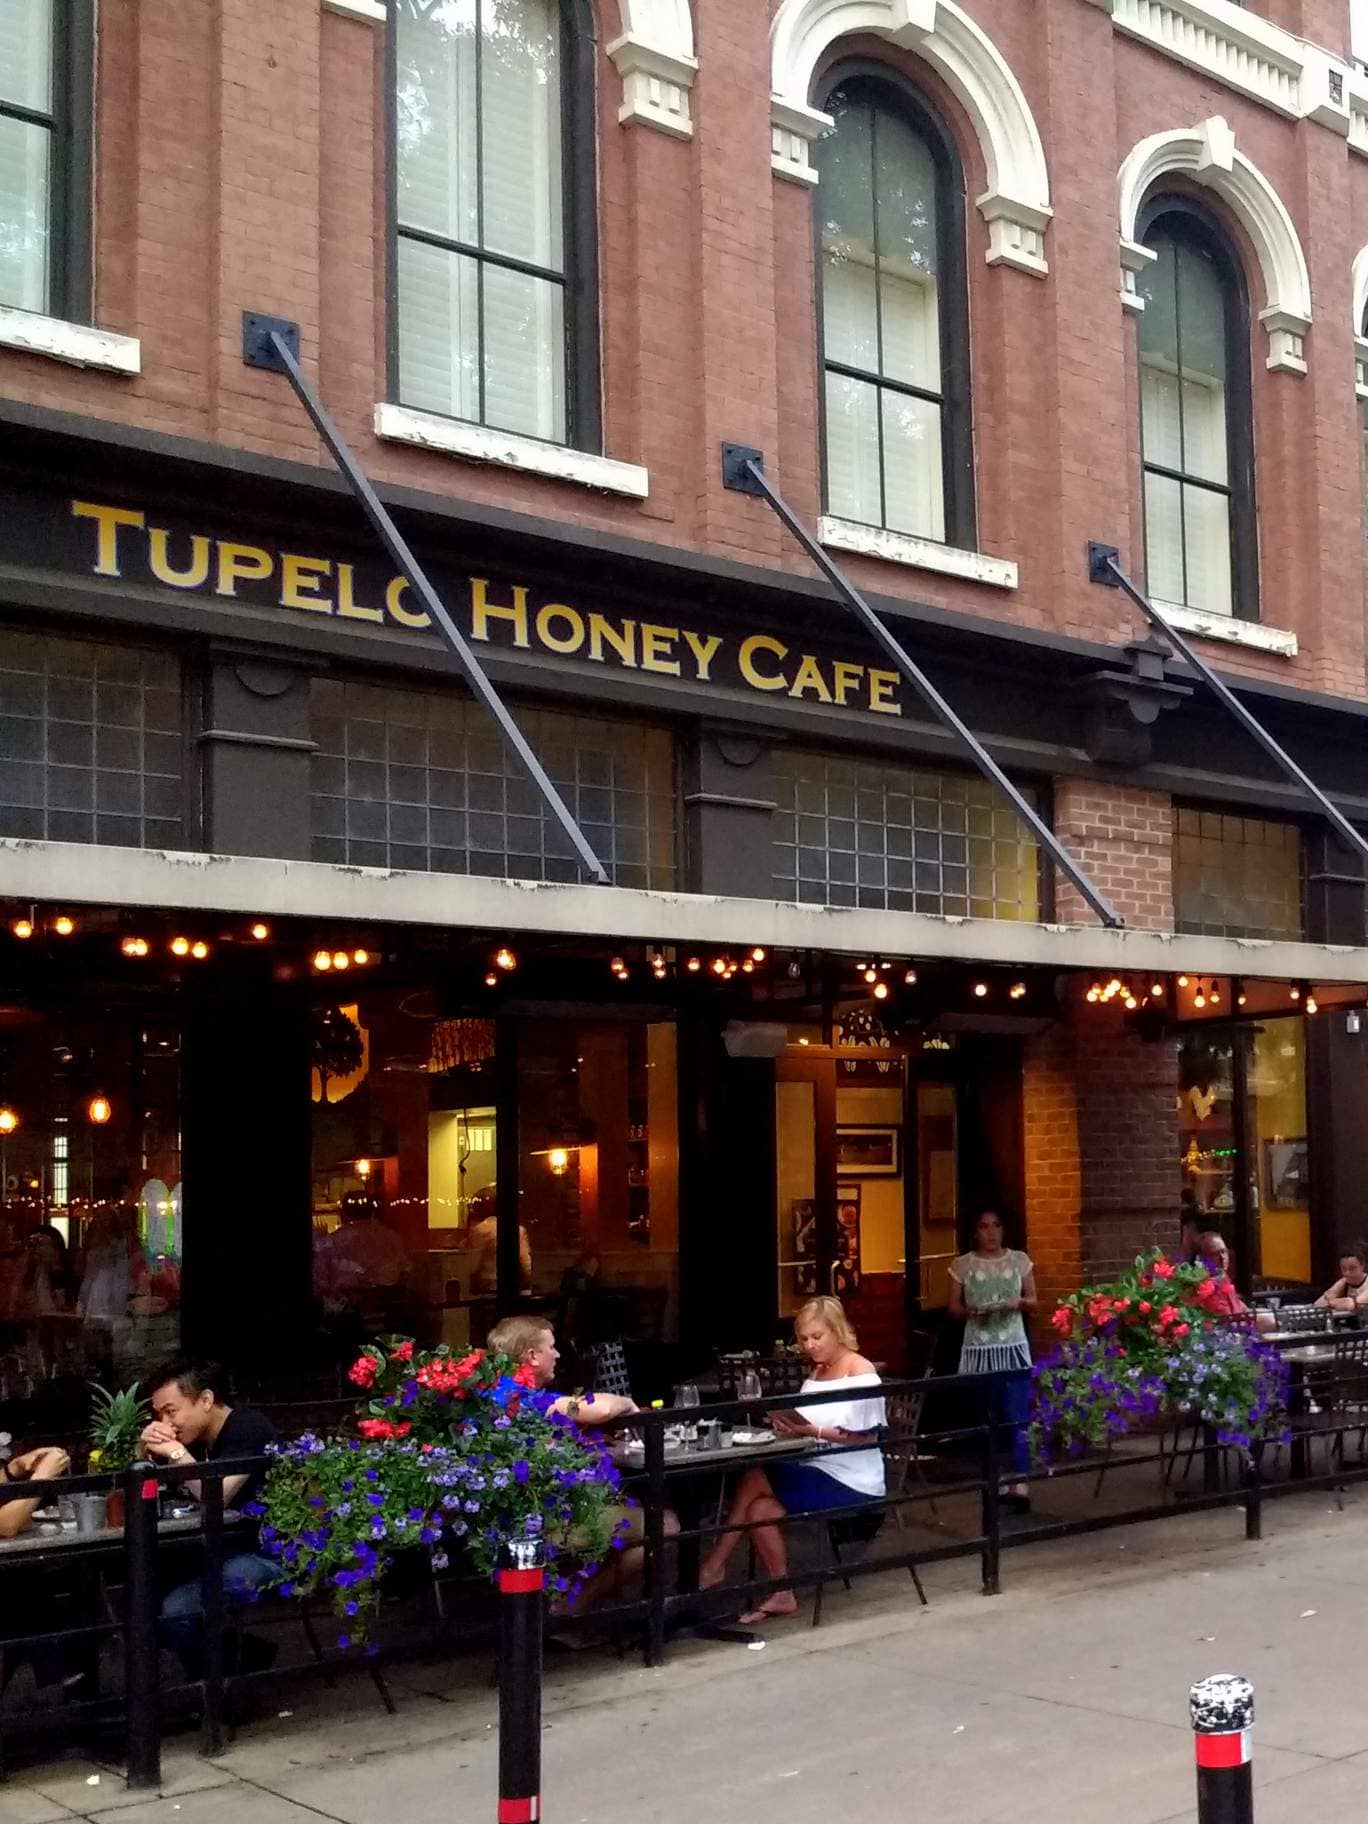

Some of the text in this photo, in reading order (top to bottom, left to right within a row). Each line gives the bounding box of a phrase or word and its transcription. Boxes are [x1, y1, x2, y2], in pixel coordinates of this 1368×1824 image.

[72, 499, 902, 715] TUPELO HONEY CAFE
